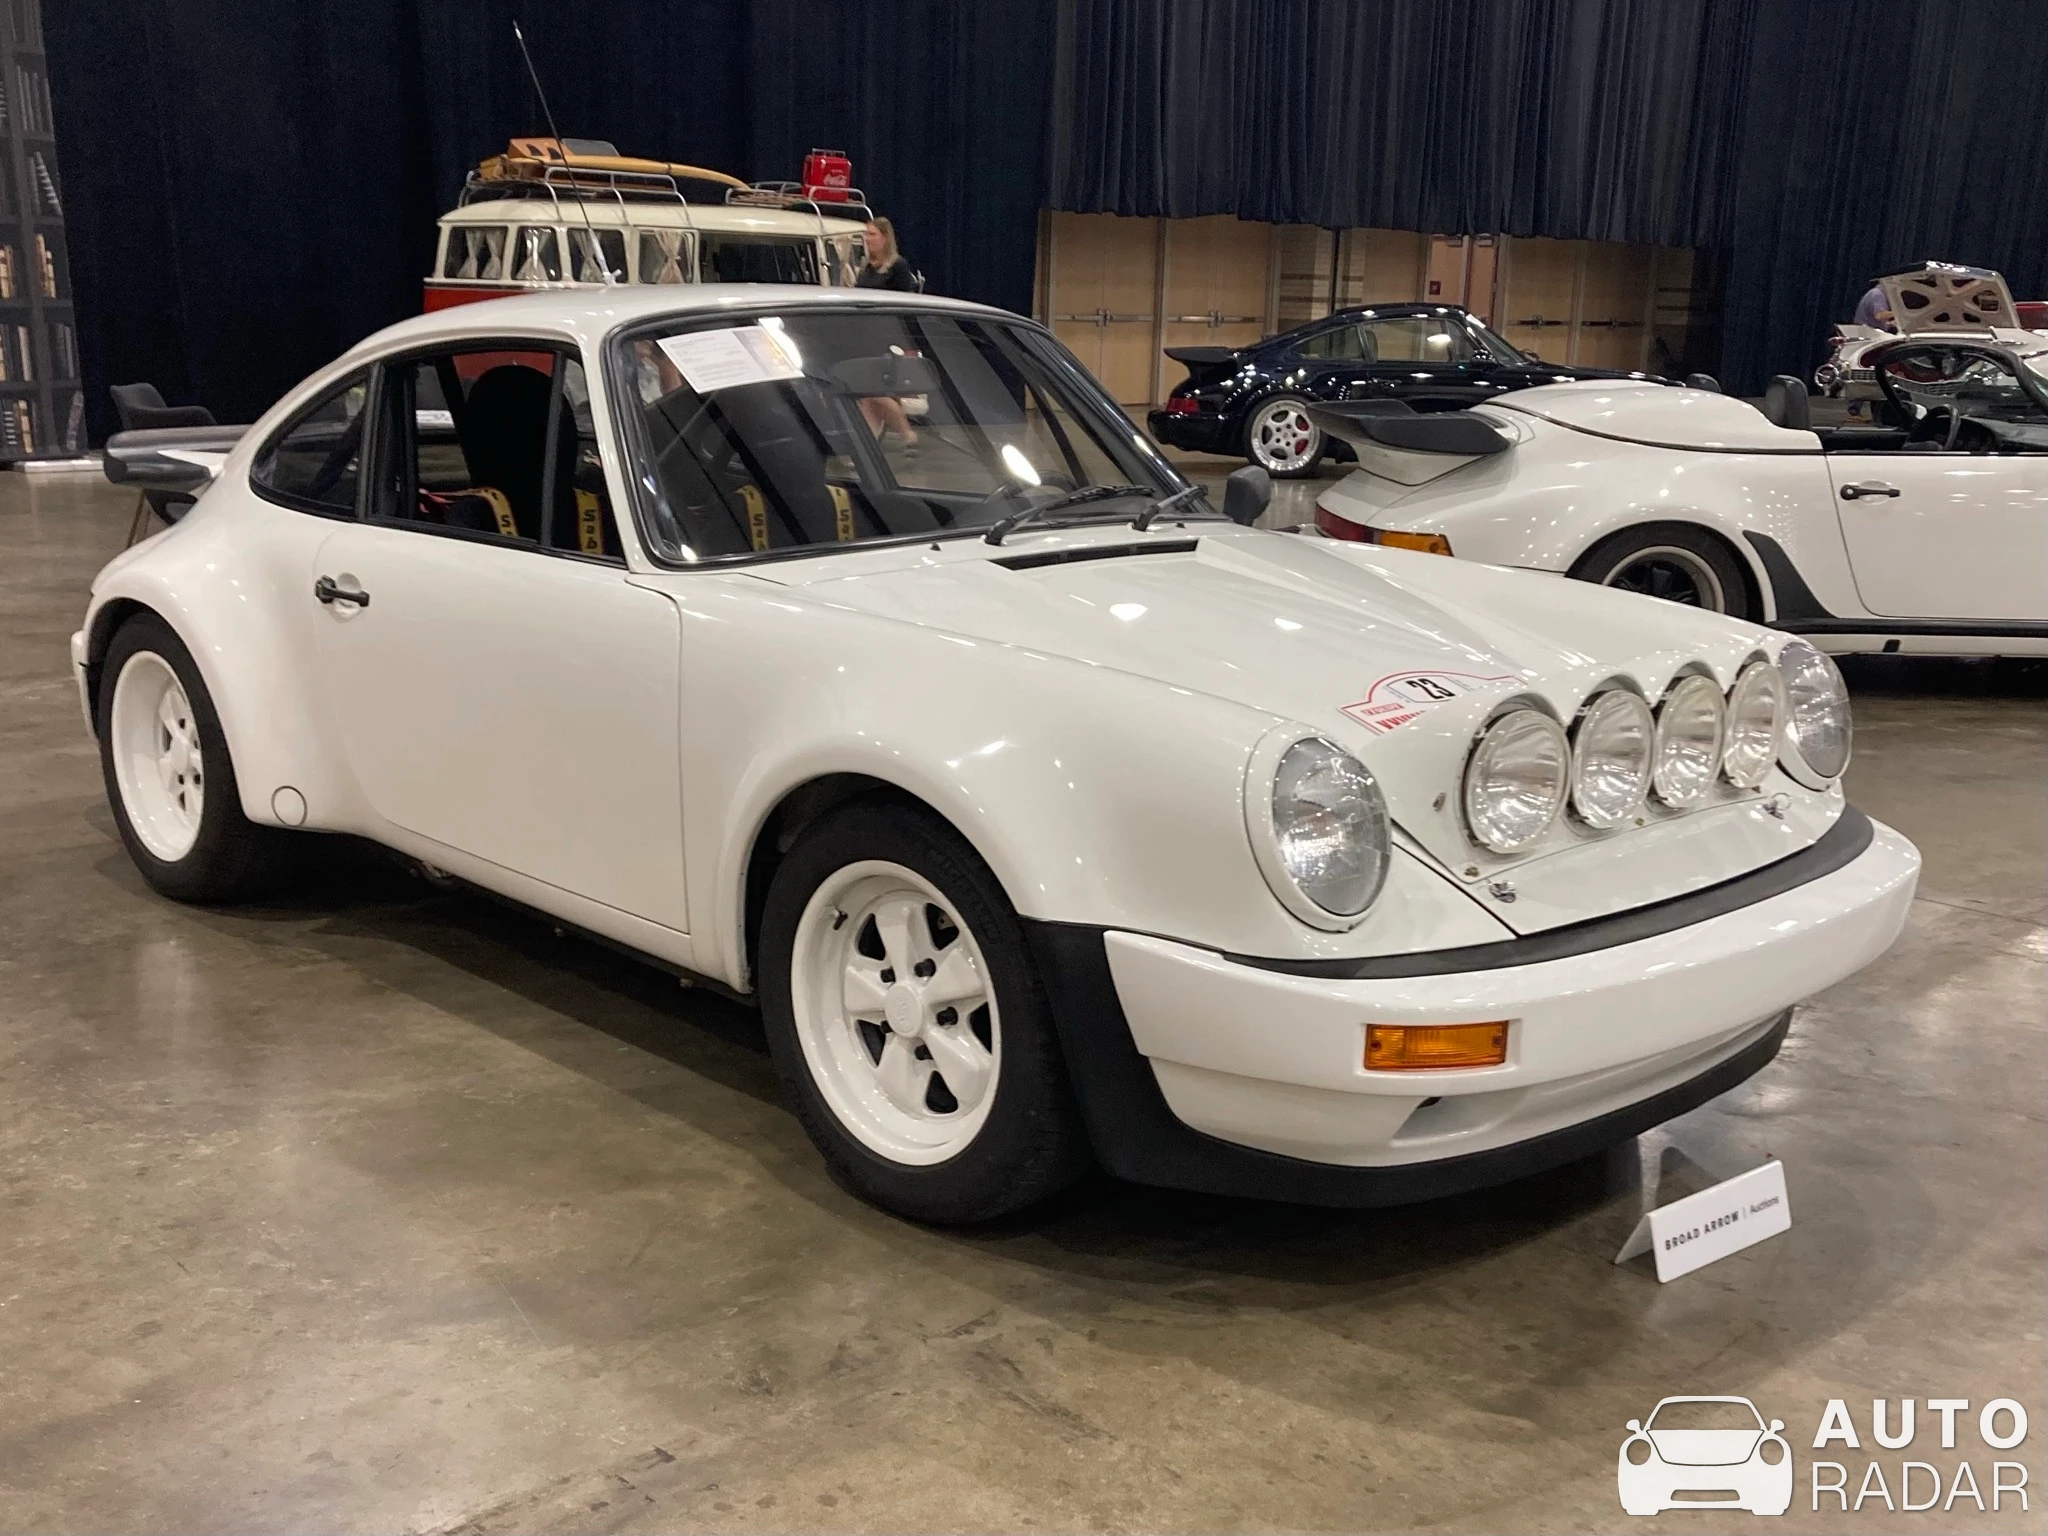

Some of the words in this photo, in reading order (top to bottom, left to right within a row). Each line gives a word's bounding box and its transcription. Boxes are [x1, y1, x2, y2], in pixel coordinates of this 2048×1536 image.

[1405, 678, 1456, 699] 23
[1665, 1228, 1700, 1250] BROAD
[1704, 1211, 1739, 1233] ARROW
[1750, 1196, 1779, 1214] Auctions
